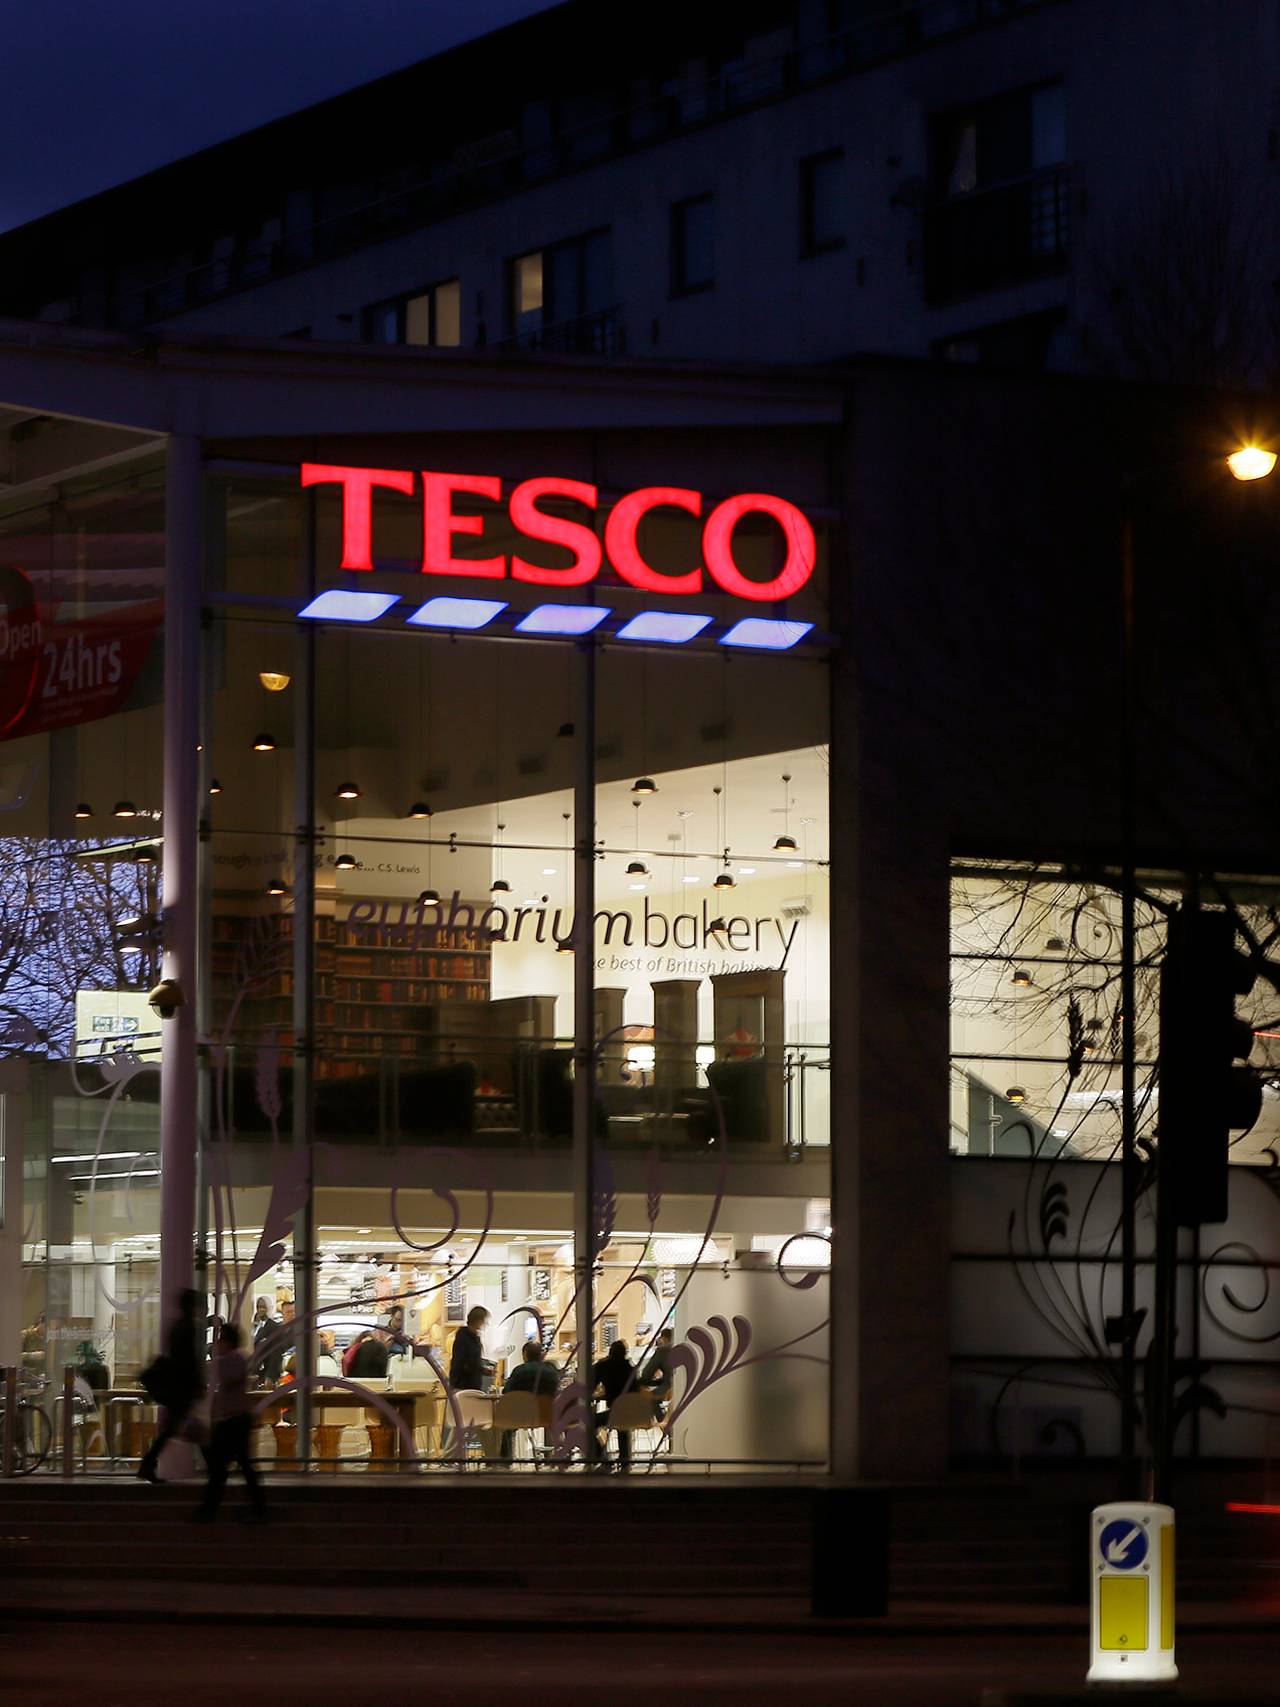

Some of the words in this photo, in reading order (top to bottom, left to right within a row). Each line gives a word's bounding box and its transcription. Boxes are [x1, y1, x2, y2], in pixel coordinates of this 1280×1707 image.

[299, 462, 818, 603] TESCO
[42, 633, 123, 699] 24hrs
[396, 864, 421, 874] Lewis
[609, 955, 643, 971] best
[647, 955, 664, 972] of
[666, 957, 716, 974] British
[642, 895, 800, 970] bakery
